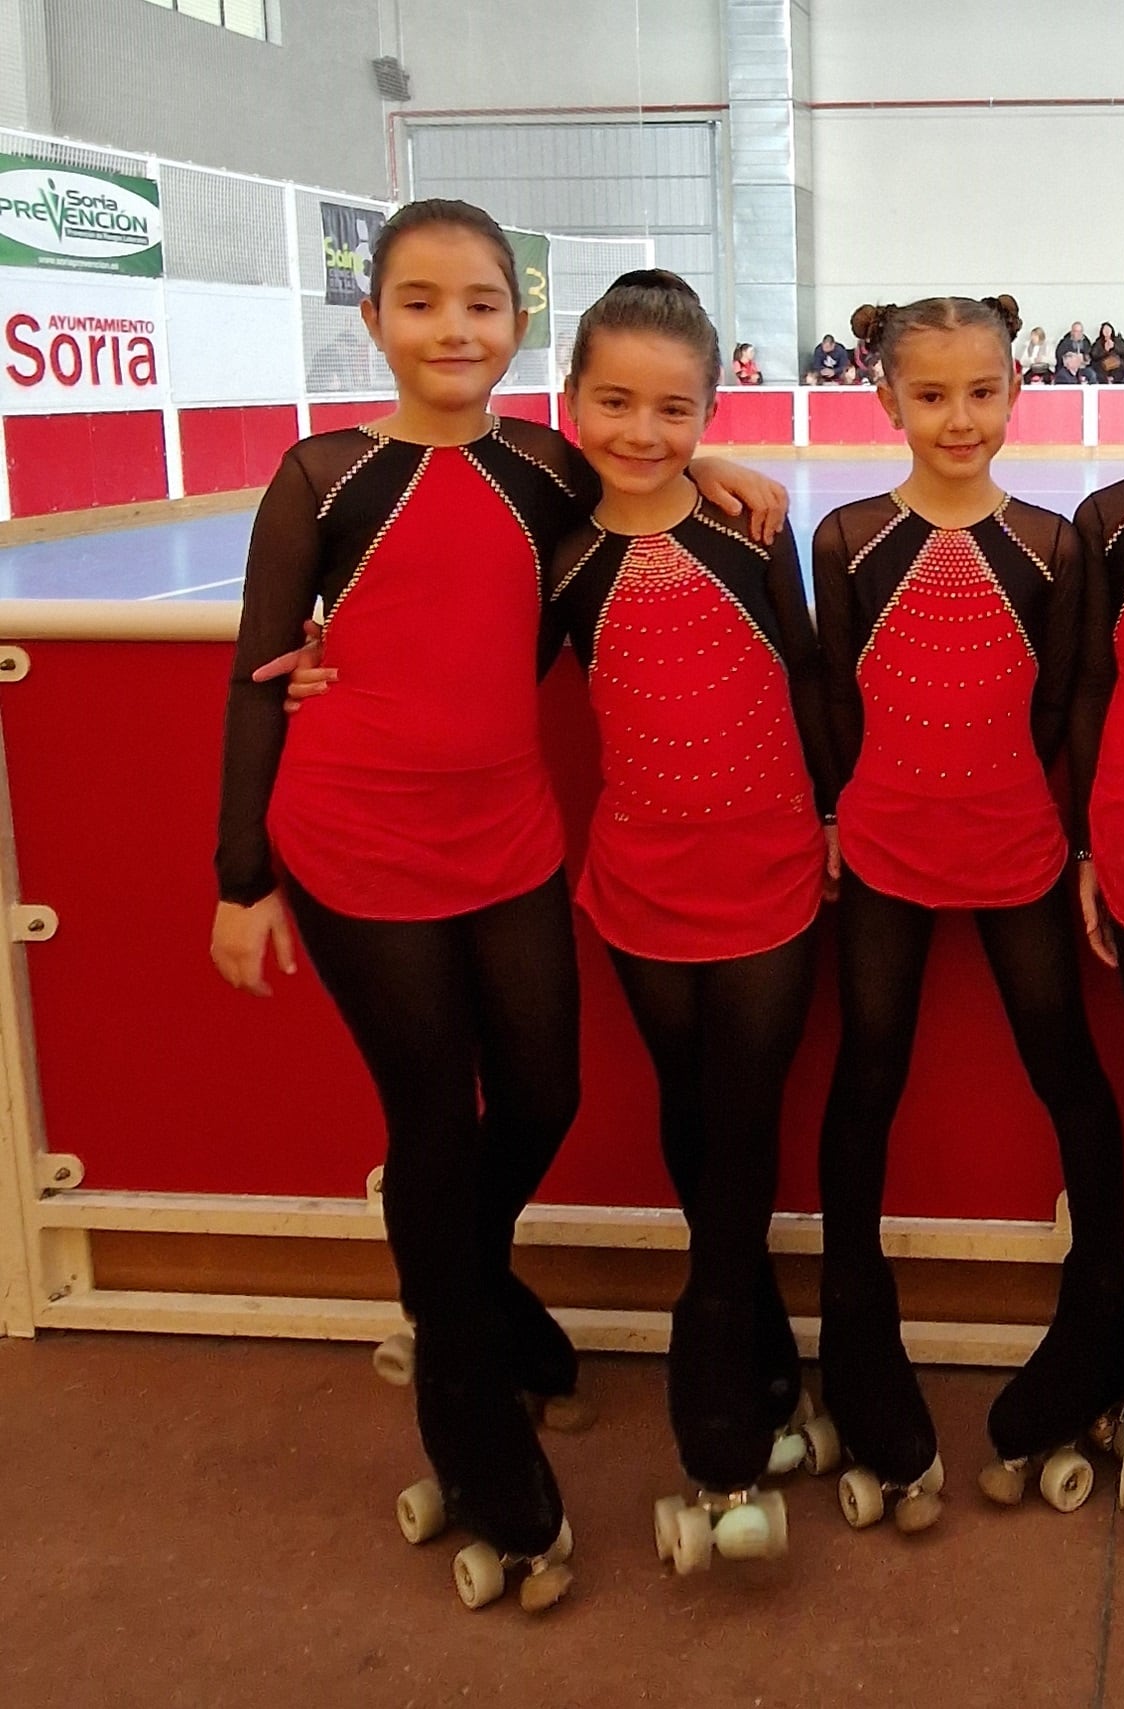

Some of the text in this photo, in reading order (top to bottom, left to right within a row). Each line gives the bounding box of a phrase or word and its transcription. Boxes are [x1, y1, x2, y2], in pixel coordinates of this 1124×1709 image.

[65, 189, 118, 211] Soria
[49, 315, 155, 334] AYUNTAMIENTO
[5, 313, 158, 387] Soria
